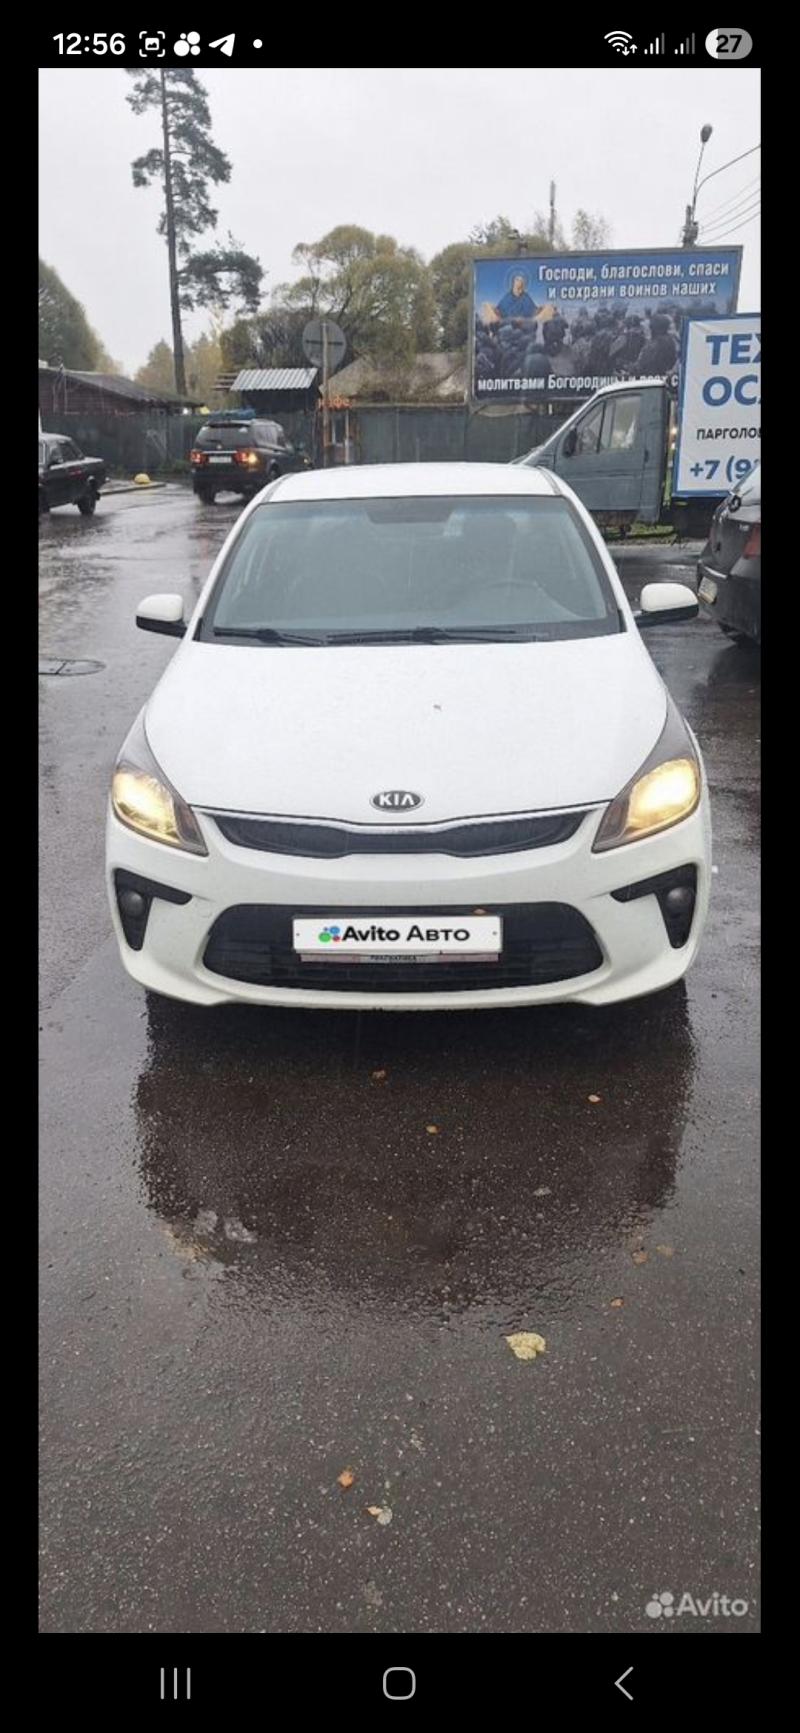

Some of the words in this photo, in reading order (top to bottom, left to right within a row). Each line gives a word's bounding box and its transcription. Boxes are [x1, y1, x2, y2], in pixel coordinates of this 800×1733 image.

[538, 264, 597, 281] Господи,
[601, 264, 684, 279] благослови,
[688, 262, 730, 277] спаси
[548, 287, 557, 298] и
[560, 283, 615, 301] сохрани
[620, 282, 668, 298] воинов
[672, 281, 717, 296] наших
[478, 377, 545, 391] молитвами
[702, 375, 761, 407] ОС
[696, 427, 761, 440] ПАРГОЛО
[689, 460, 720, 480] +7
[726, 455, 759, 482] (9
